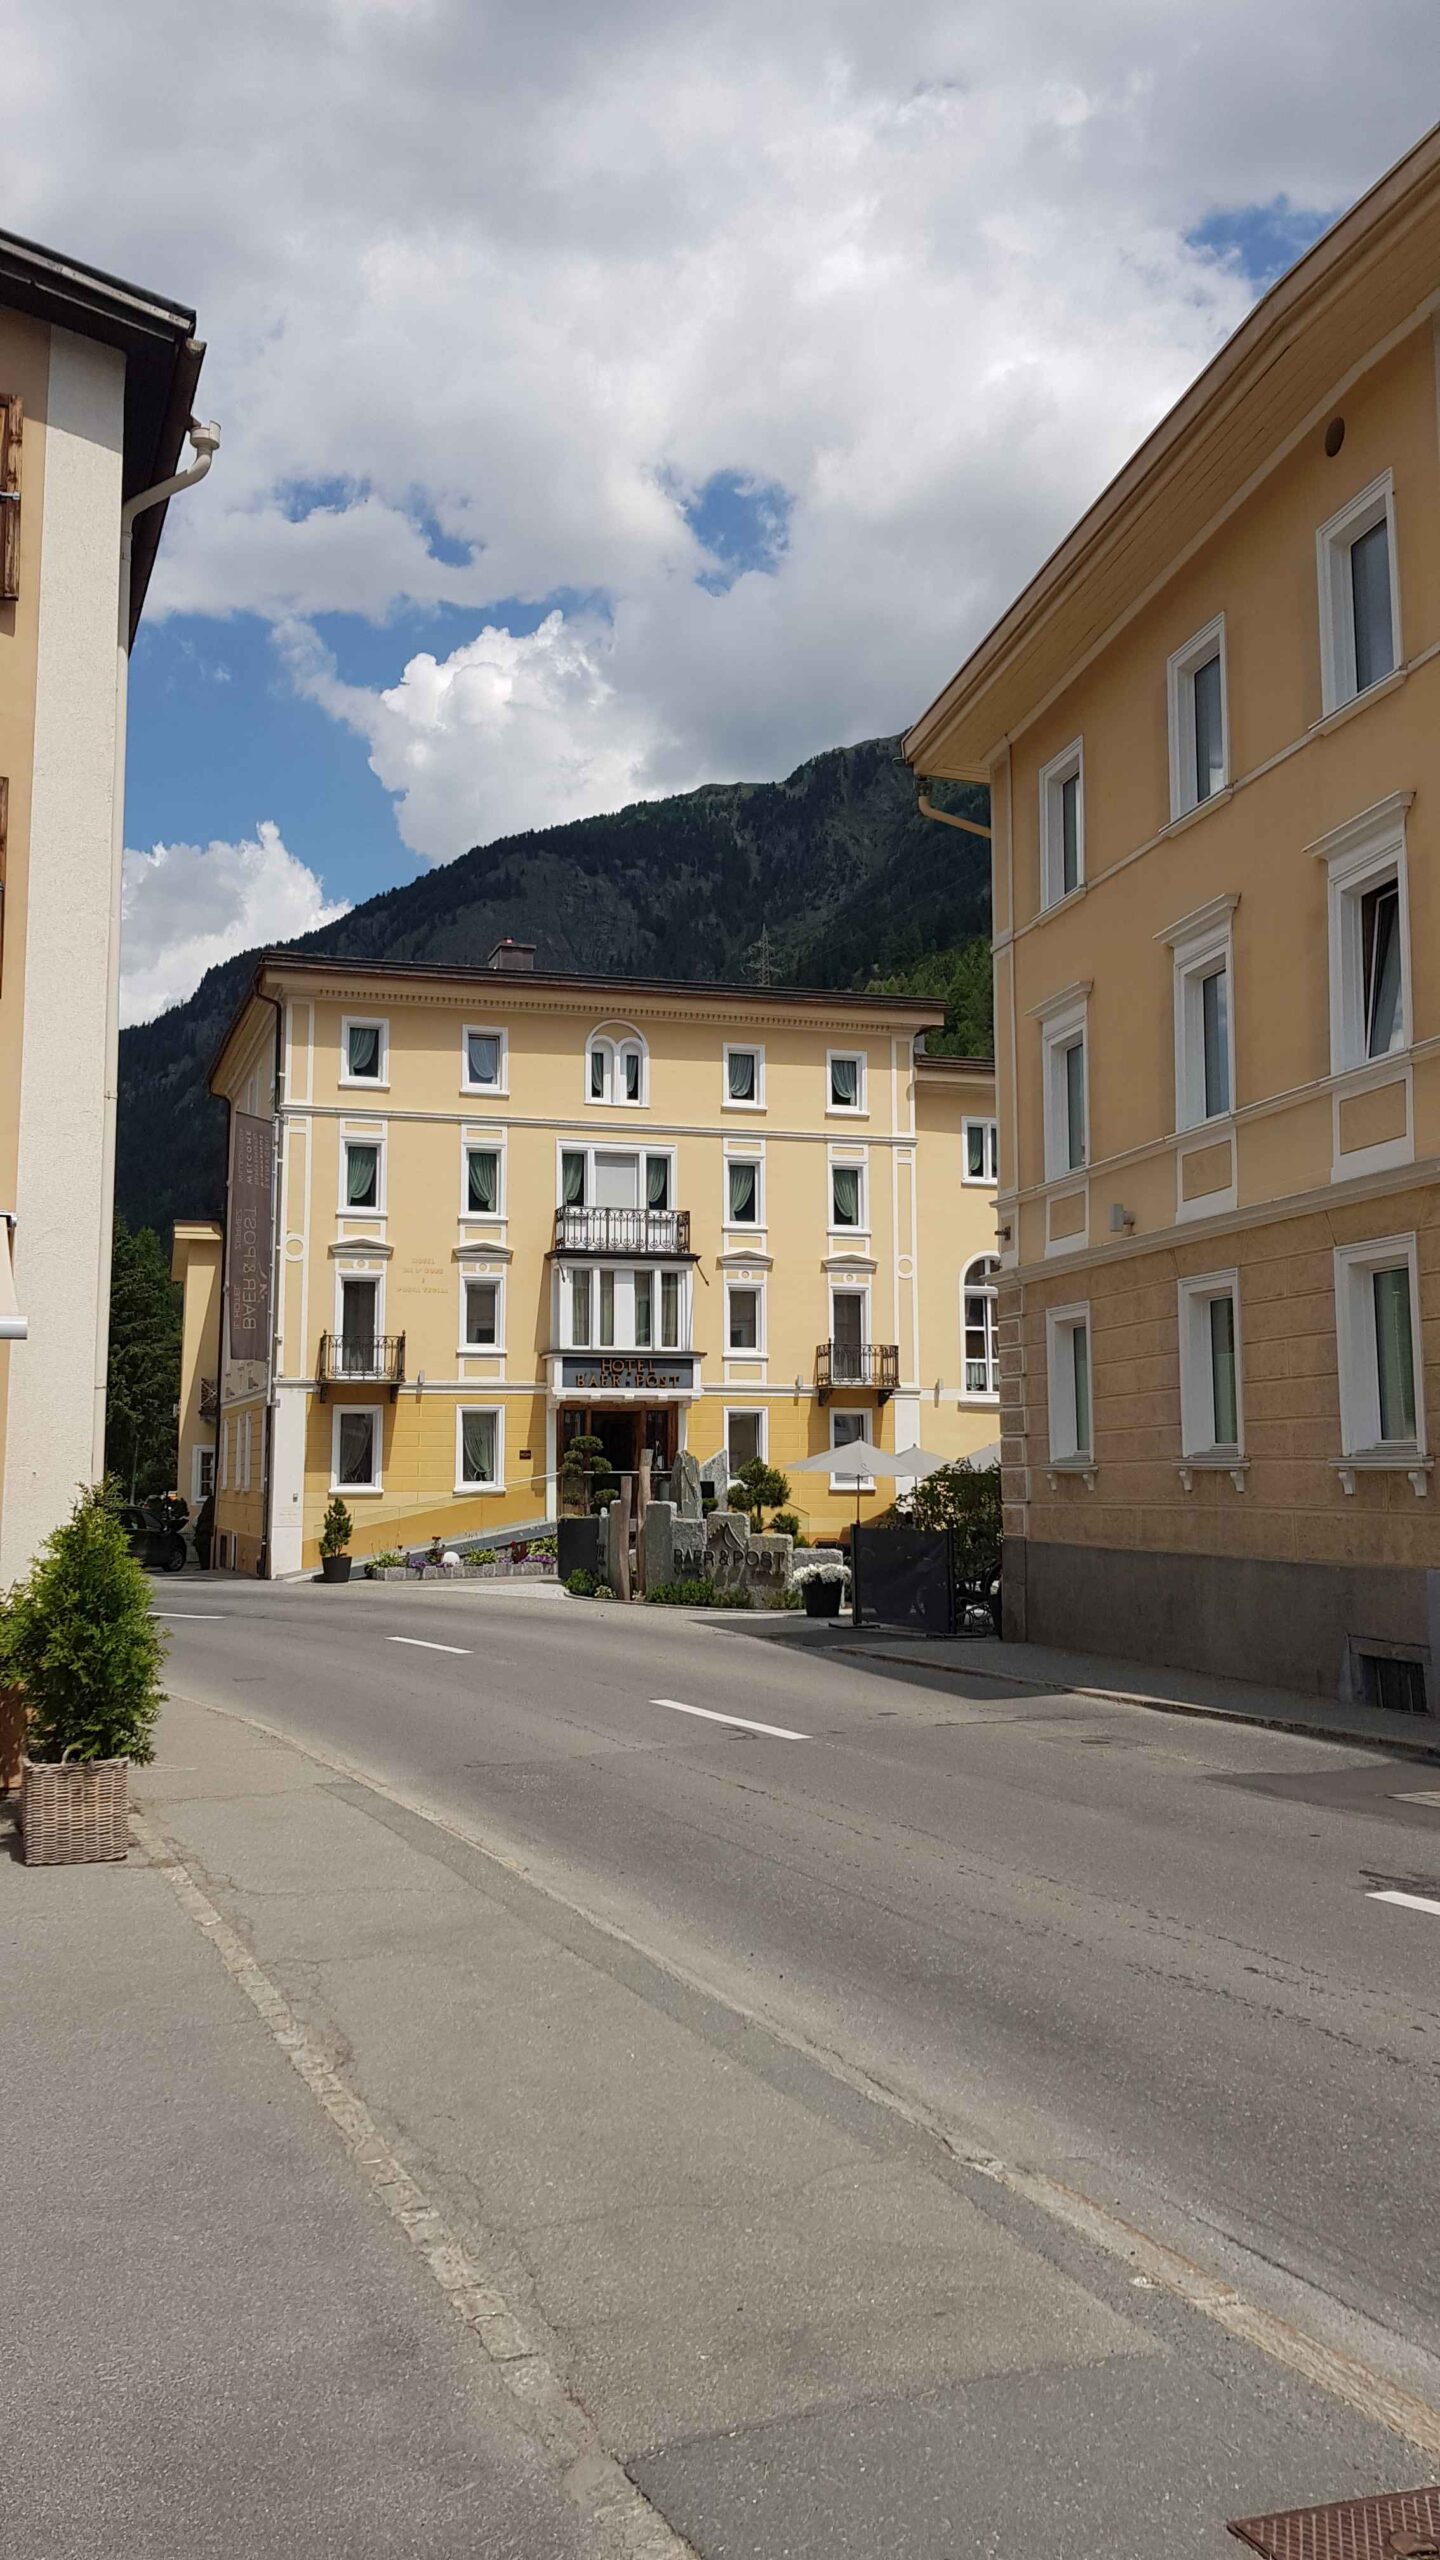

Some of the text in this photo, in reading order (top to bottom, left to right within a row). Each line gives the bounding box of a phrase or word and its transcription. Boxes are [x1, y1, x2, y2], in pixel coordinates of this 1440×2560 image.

[601, 1359, 655, 1373] HOTEL
[576, 1373, 680, 1388] BAER POST
[673, 1548, 786, 1572] BAER & POST
